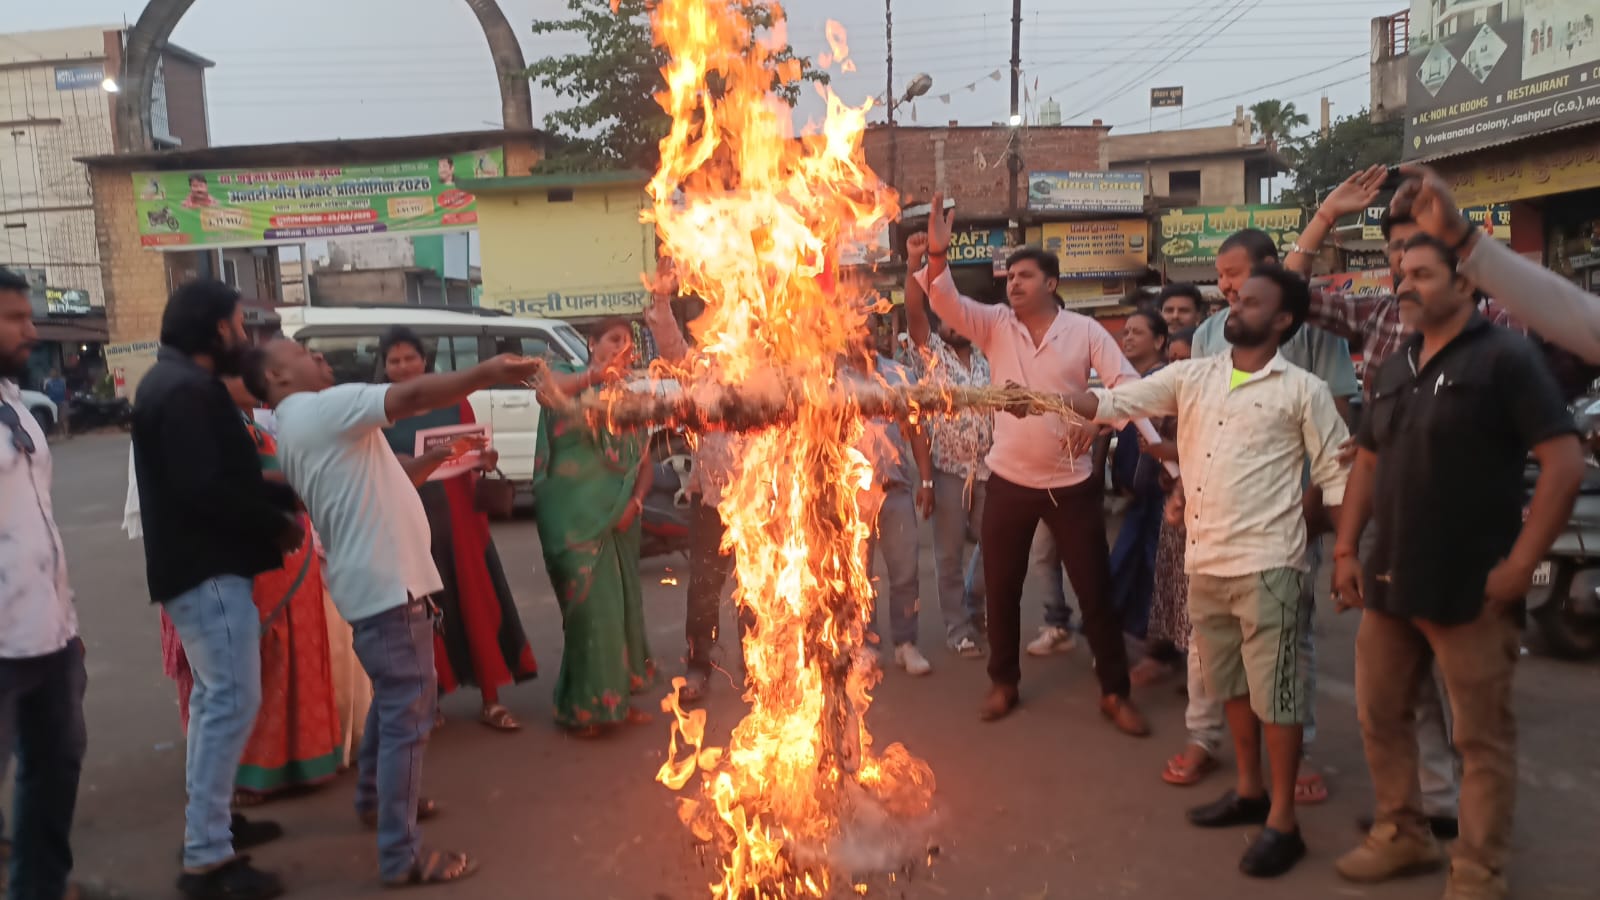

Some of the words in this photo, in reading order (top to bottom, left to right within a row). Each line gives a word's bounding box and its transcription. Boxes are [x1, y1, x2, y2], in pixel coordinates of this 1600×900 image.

[1419, 106, 1447, 124] AC-NON
[1449, 103, 1459, 116] AC
[1460, 96, 1489, 114] ROOMS
[1506, 74, 1570, 101] RESTAURANT
[1424, 124, 1475, 145] Vivekanand
[1475, 118, 1511, 133] Colony,
[1511, 107, 1552, 126] Jashpur
[1552, 95, 1585, 117] (C.G.),
[397, 177, 431, 192] 2026
[1161, 209, 1206, 239] होटल
[948, 230, 990, 247] RAFT
[946, 244, 995, 261] ILORS
[564, 293, 598, 311] पान
